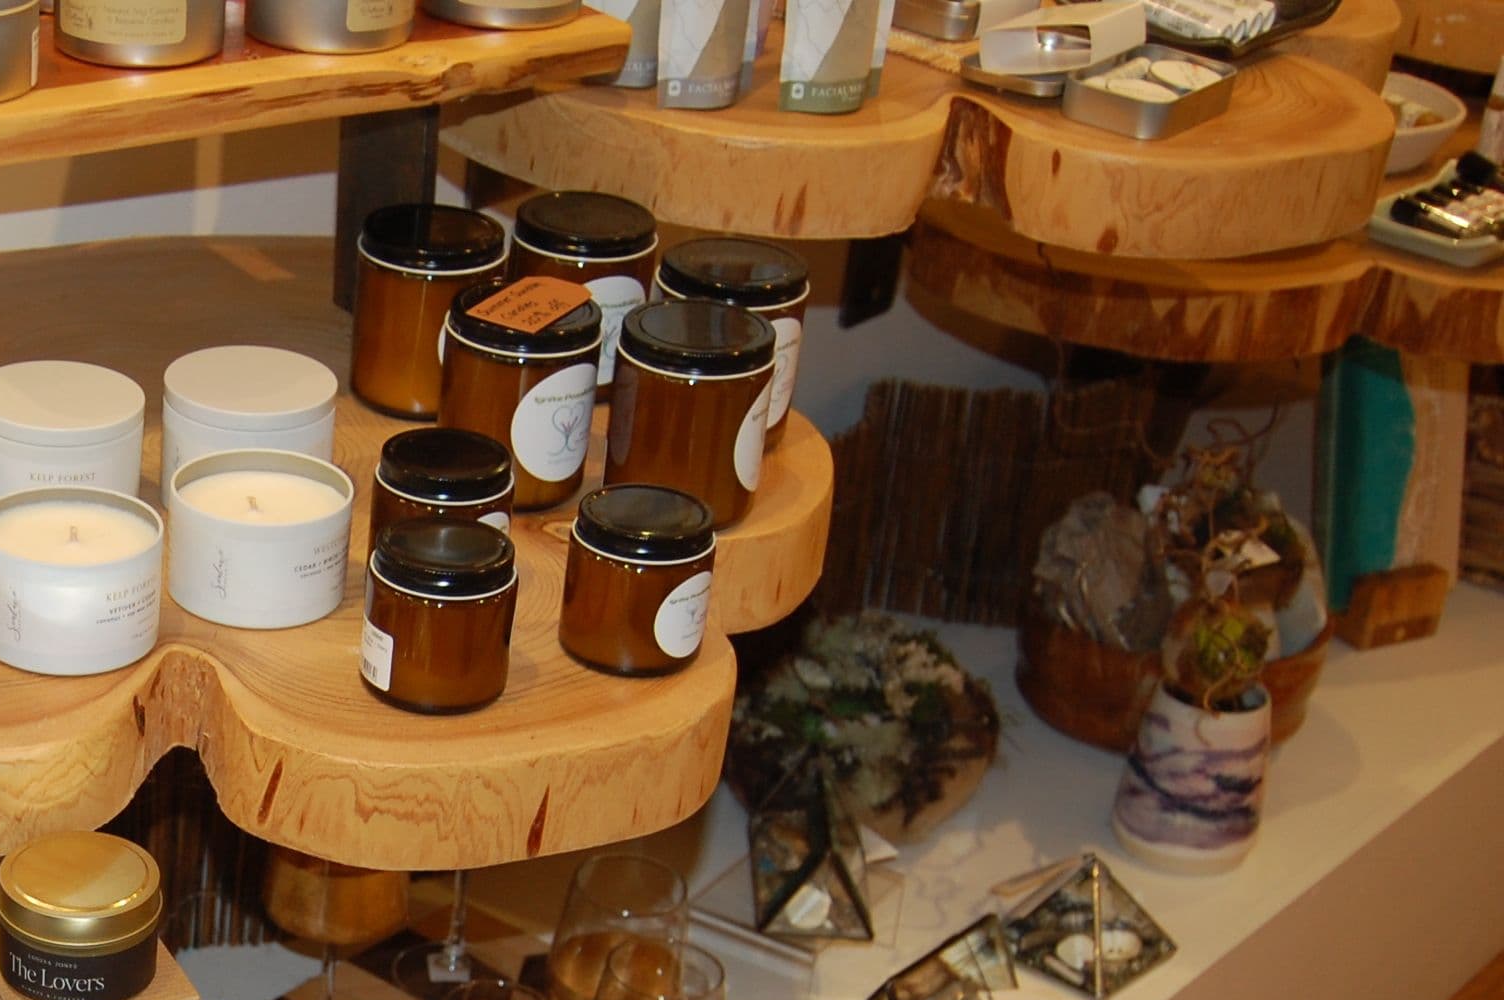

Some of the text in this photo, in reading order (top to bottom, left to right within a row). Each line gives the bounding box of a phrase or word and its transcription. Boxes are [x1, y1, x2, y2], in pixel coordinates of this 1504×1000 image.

[811, 86, 848, 97] FACIAL
[27, 953, 79, 970] LOUISA JONES
[9, 951, 106, 994] The Lovers
